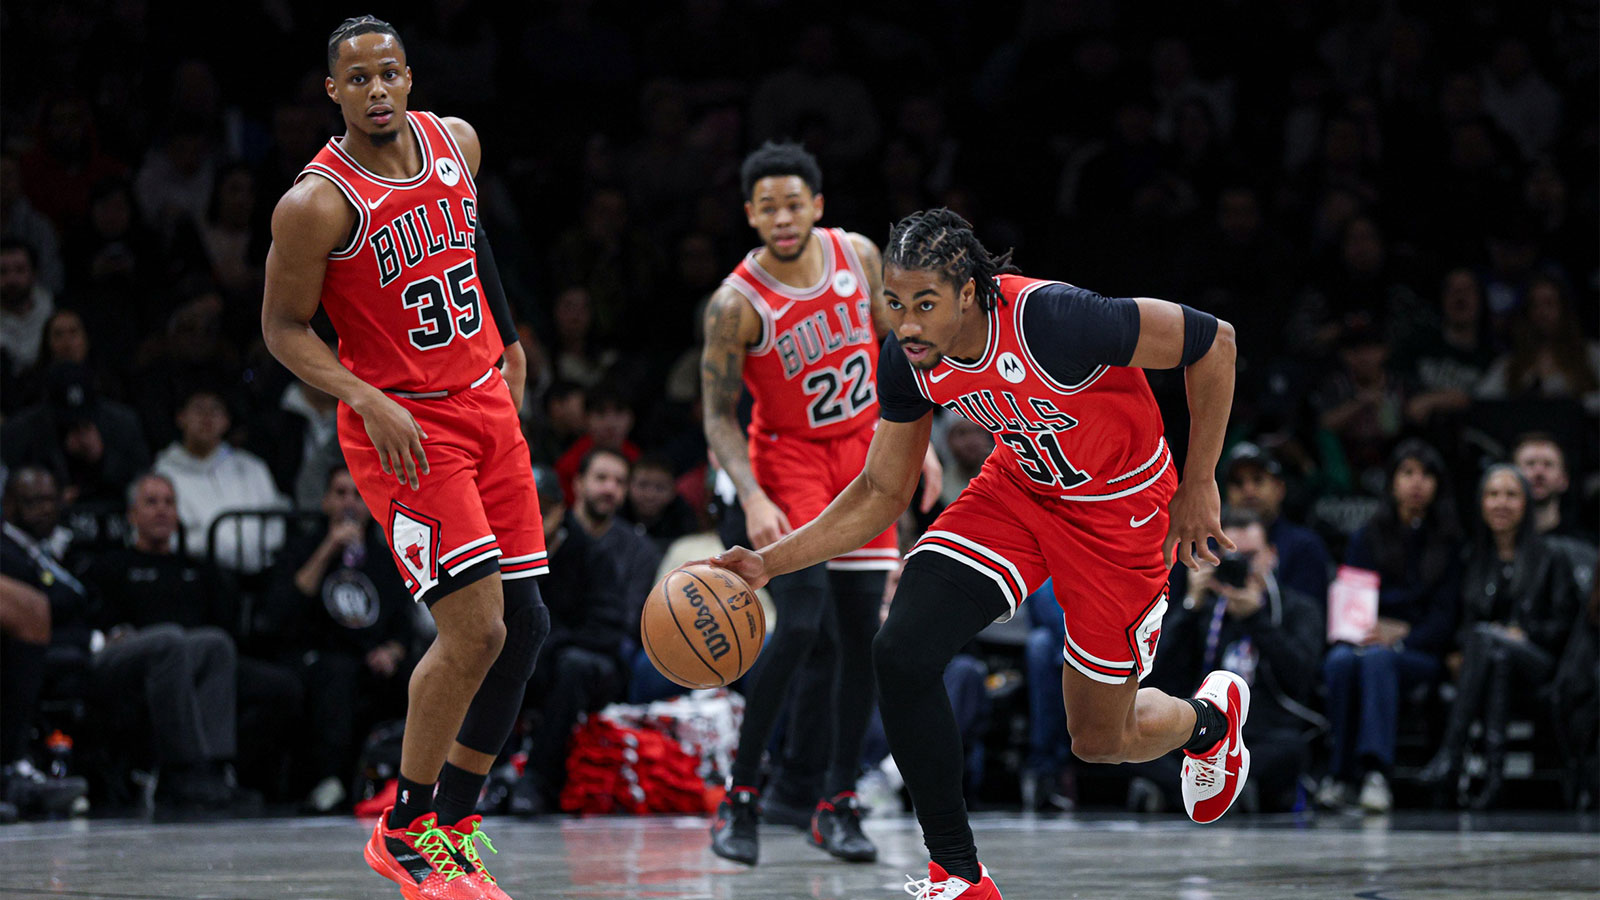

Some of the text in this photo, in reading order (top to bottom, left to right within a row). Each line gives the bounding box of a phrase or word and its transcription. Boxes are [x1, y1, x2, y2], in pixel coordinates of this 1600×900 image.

[369, 198, 476, 288] BULLS
[401, 258, 483, 351] 35
[802, 349, 878, 428] 22
[999, 431, 1093, 490] 31
[682, 581, 731, 662] Wilson
